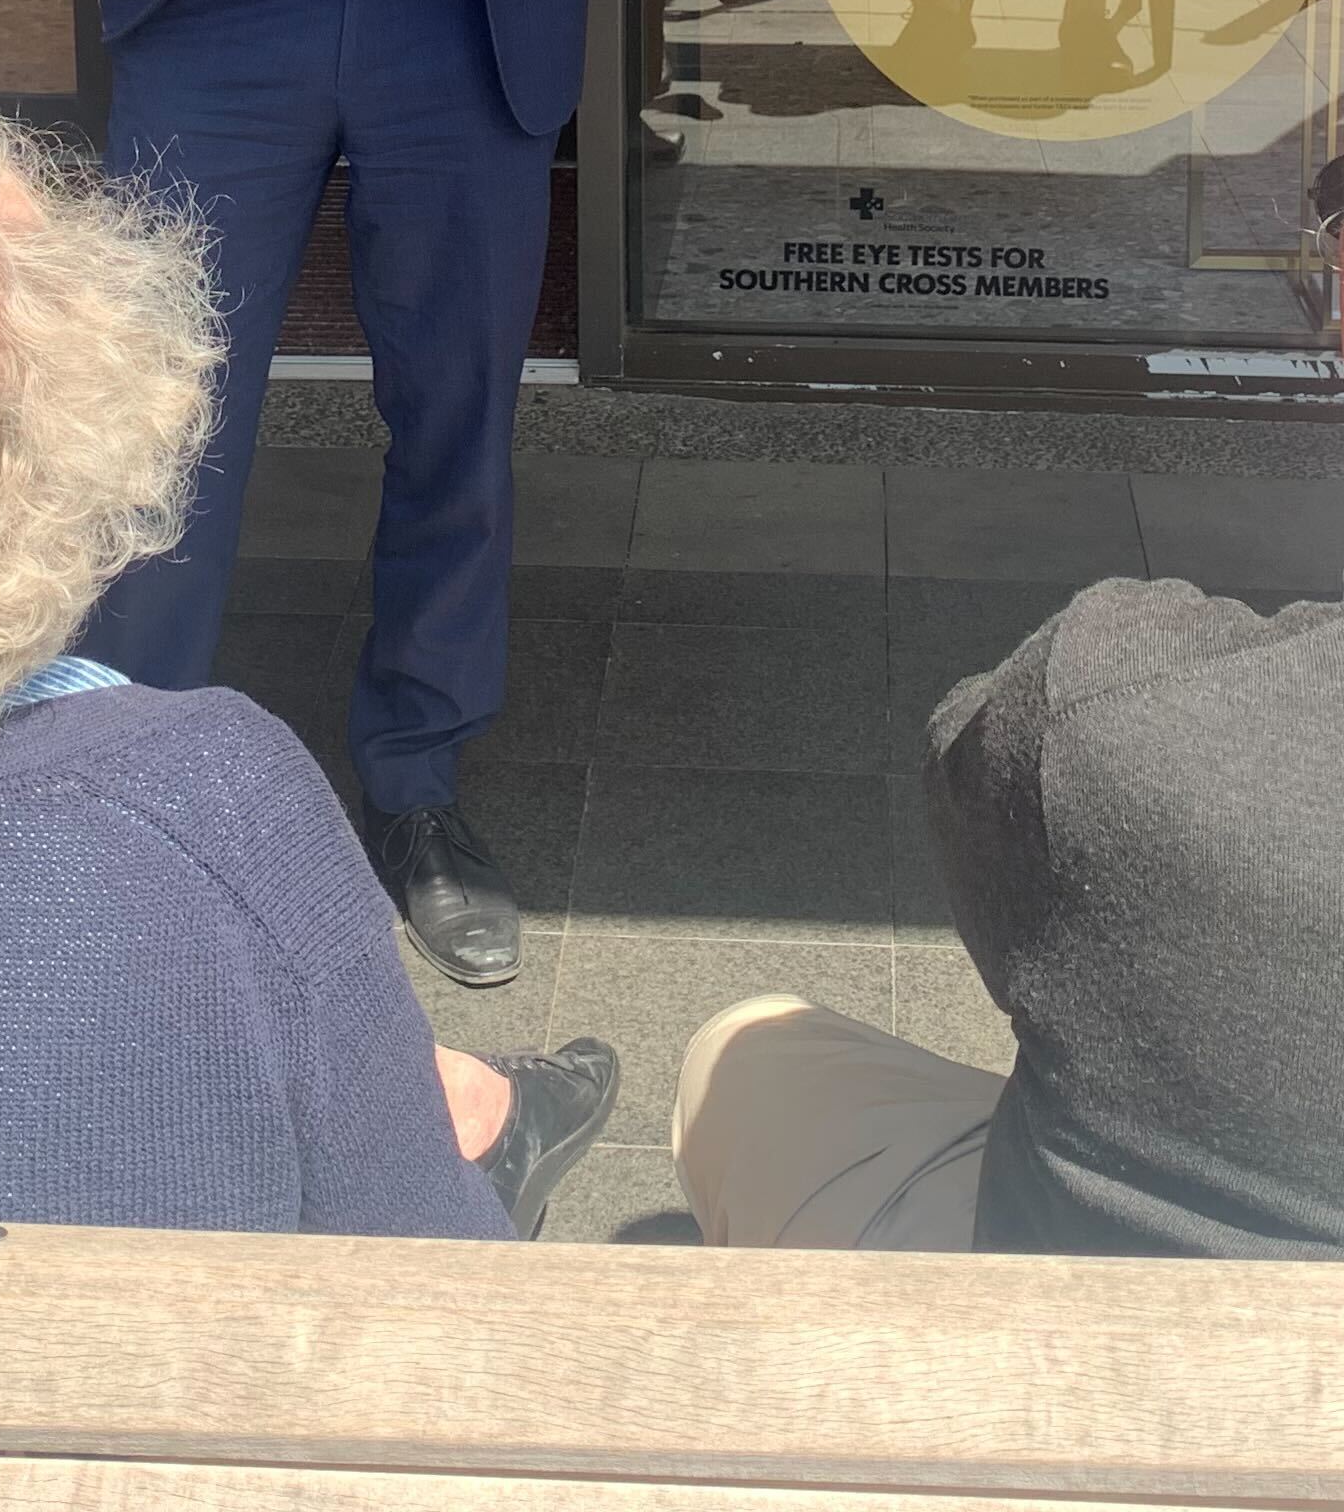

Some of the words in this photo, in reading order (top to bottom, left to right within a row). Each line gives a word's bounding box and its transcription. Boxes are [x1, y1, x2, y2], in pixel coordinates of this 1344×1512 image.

[882, 222, 917, 234] Health
[918, 223, 956, 235] Society
[783, 241, 844, 266] FREE
[852, 242, 901, 267] EYE
[907, 244, 982, 269] TESTS
[990, 246, 1046, 270] FOR
[719, 268, 870, 294] SOUTHERN
[878, 272, 968, 297] CROSS
[975, 275, 1110, 300] MEMBERS
